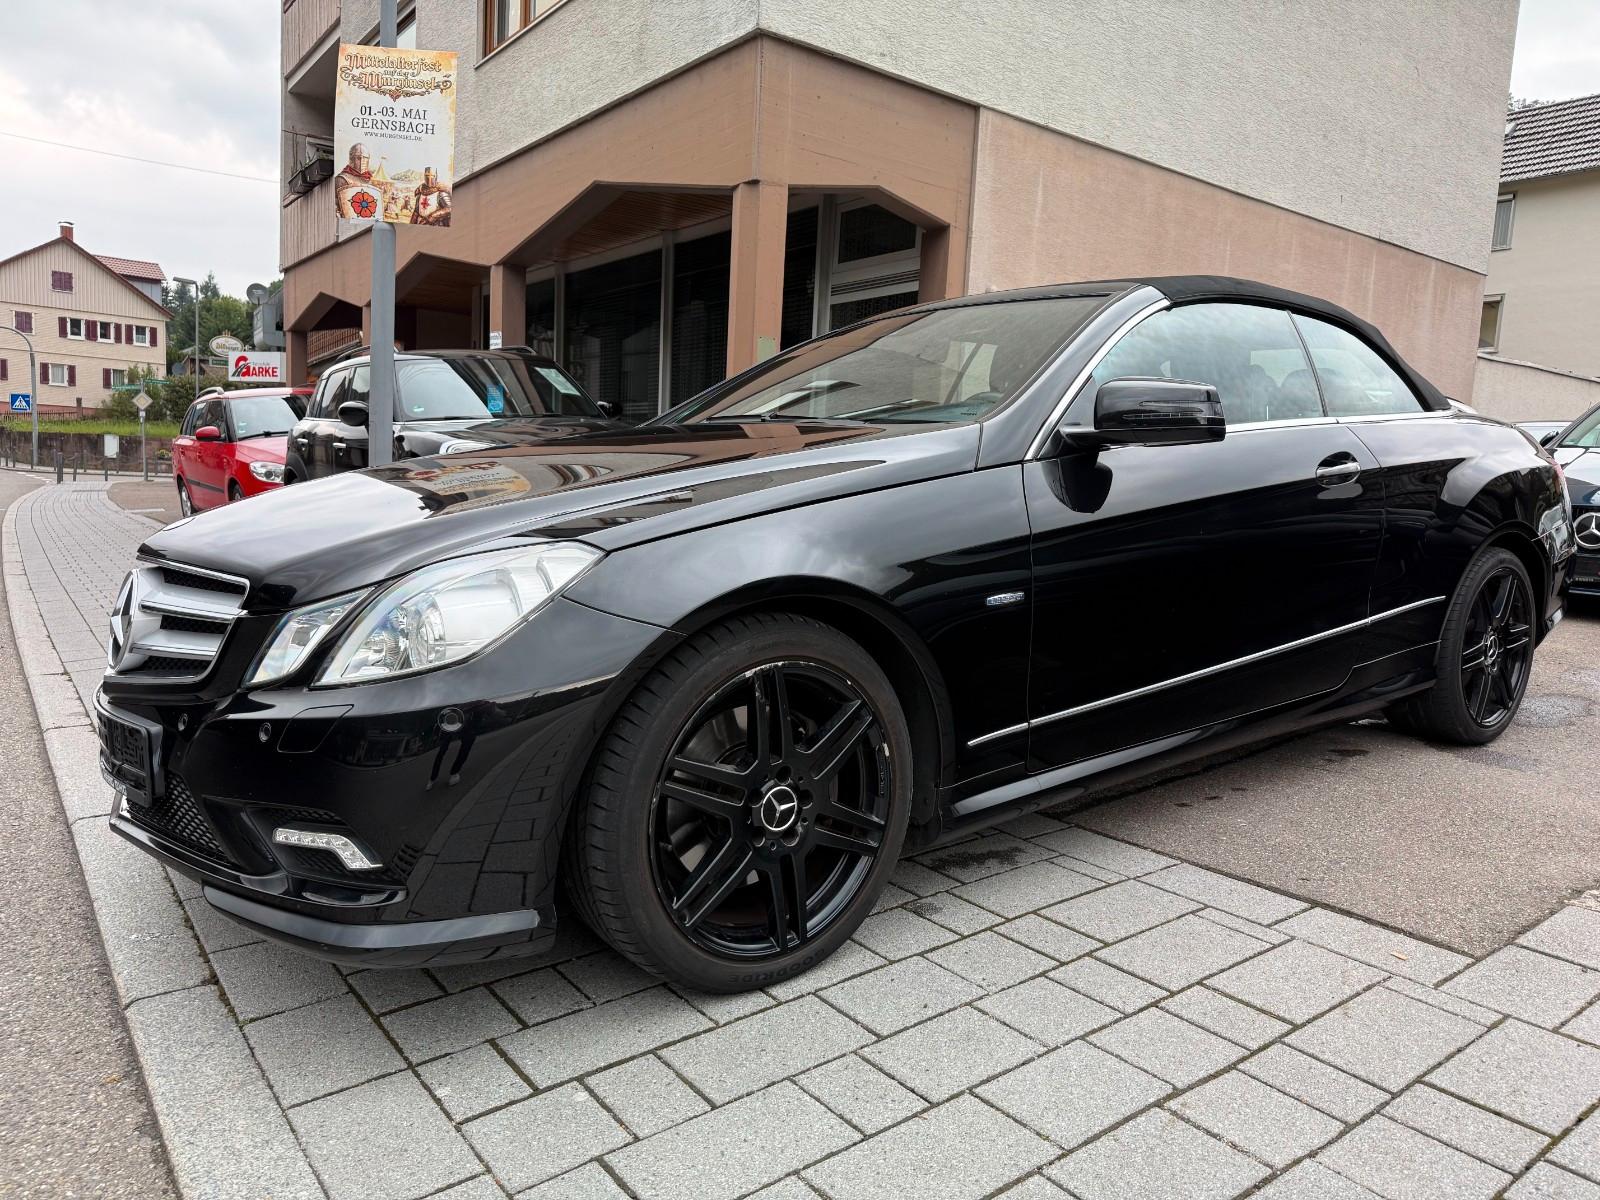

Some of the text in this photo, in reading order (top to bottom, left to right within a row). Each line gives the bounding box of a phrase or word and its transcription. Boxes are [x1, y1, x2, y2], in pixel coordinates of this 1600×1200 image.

[345, 52, 441, 76] Mittelalterfest
[360, 71, 436, 90] Murginsel
[360, 105, 428, 120] 01.-03. MAI
[351, 117, 435, 134] GERNSBACH
[363, 131, 423, 141] WWW.MURGINSEL.DE
